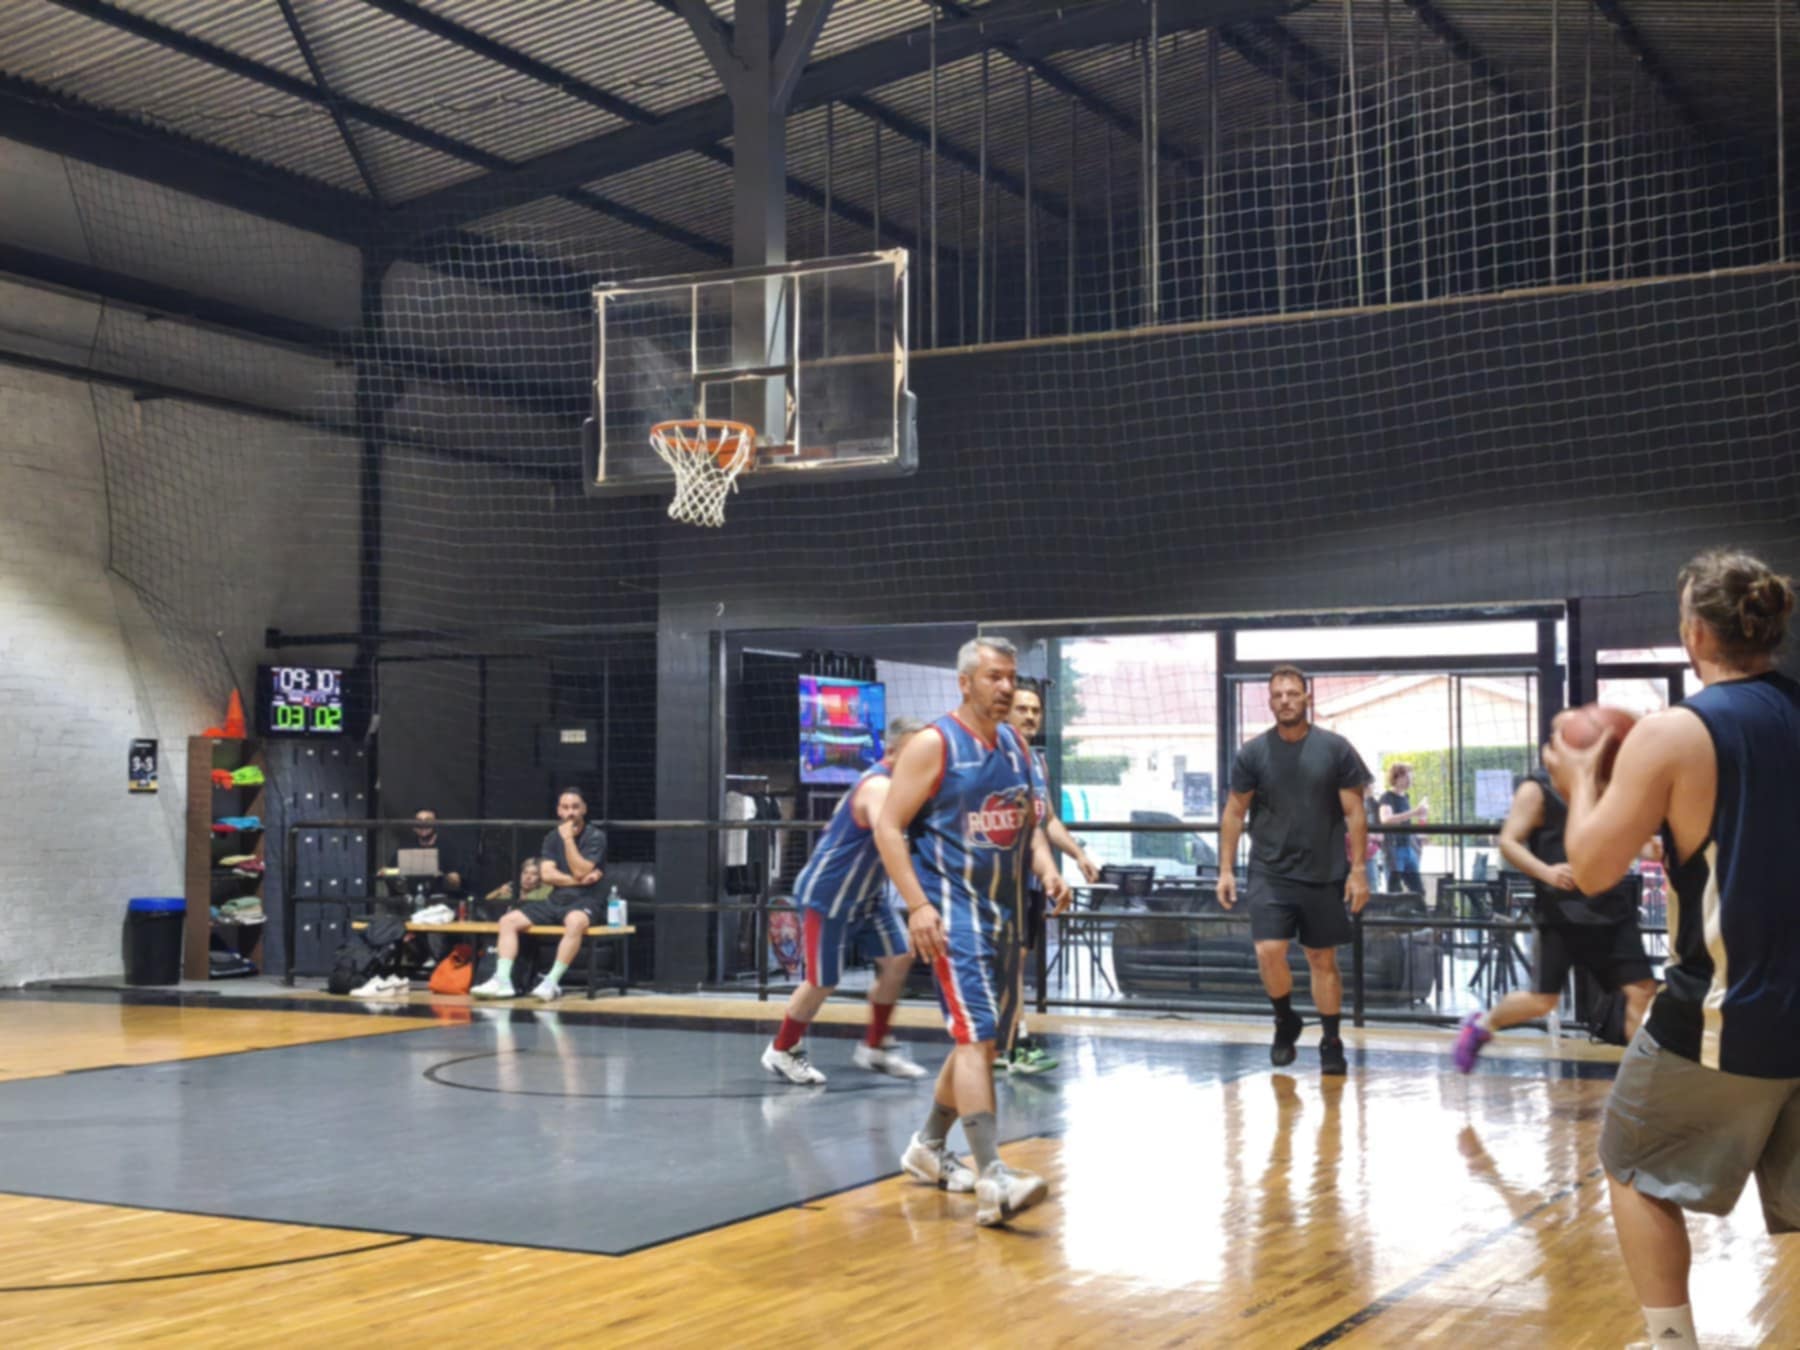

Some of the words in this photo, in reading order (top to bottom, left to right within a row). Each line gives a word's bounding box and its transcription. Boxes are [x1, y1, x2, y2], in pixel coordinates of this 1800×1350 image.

[280, 668, 334, 693] 09:10
[277, 705, 305, 730] 03
[315, 706, 342, 731] 02
